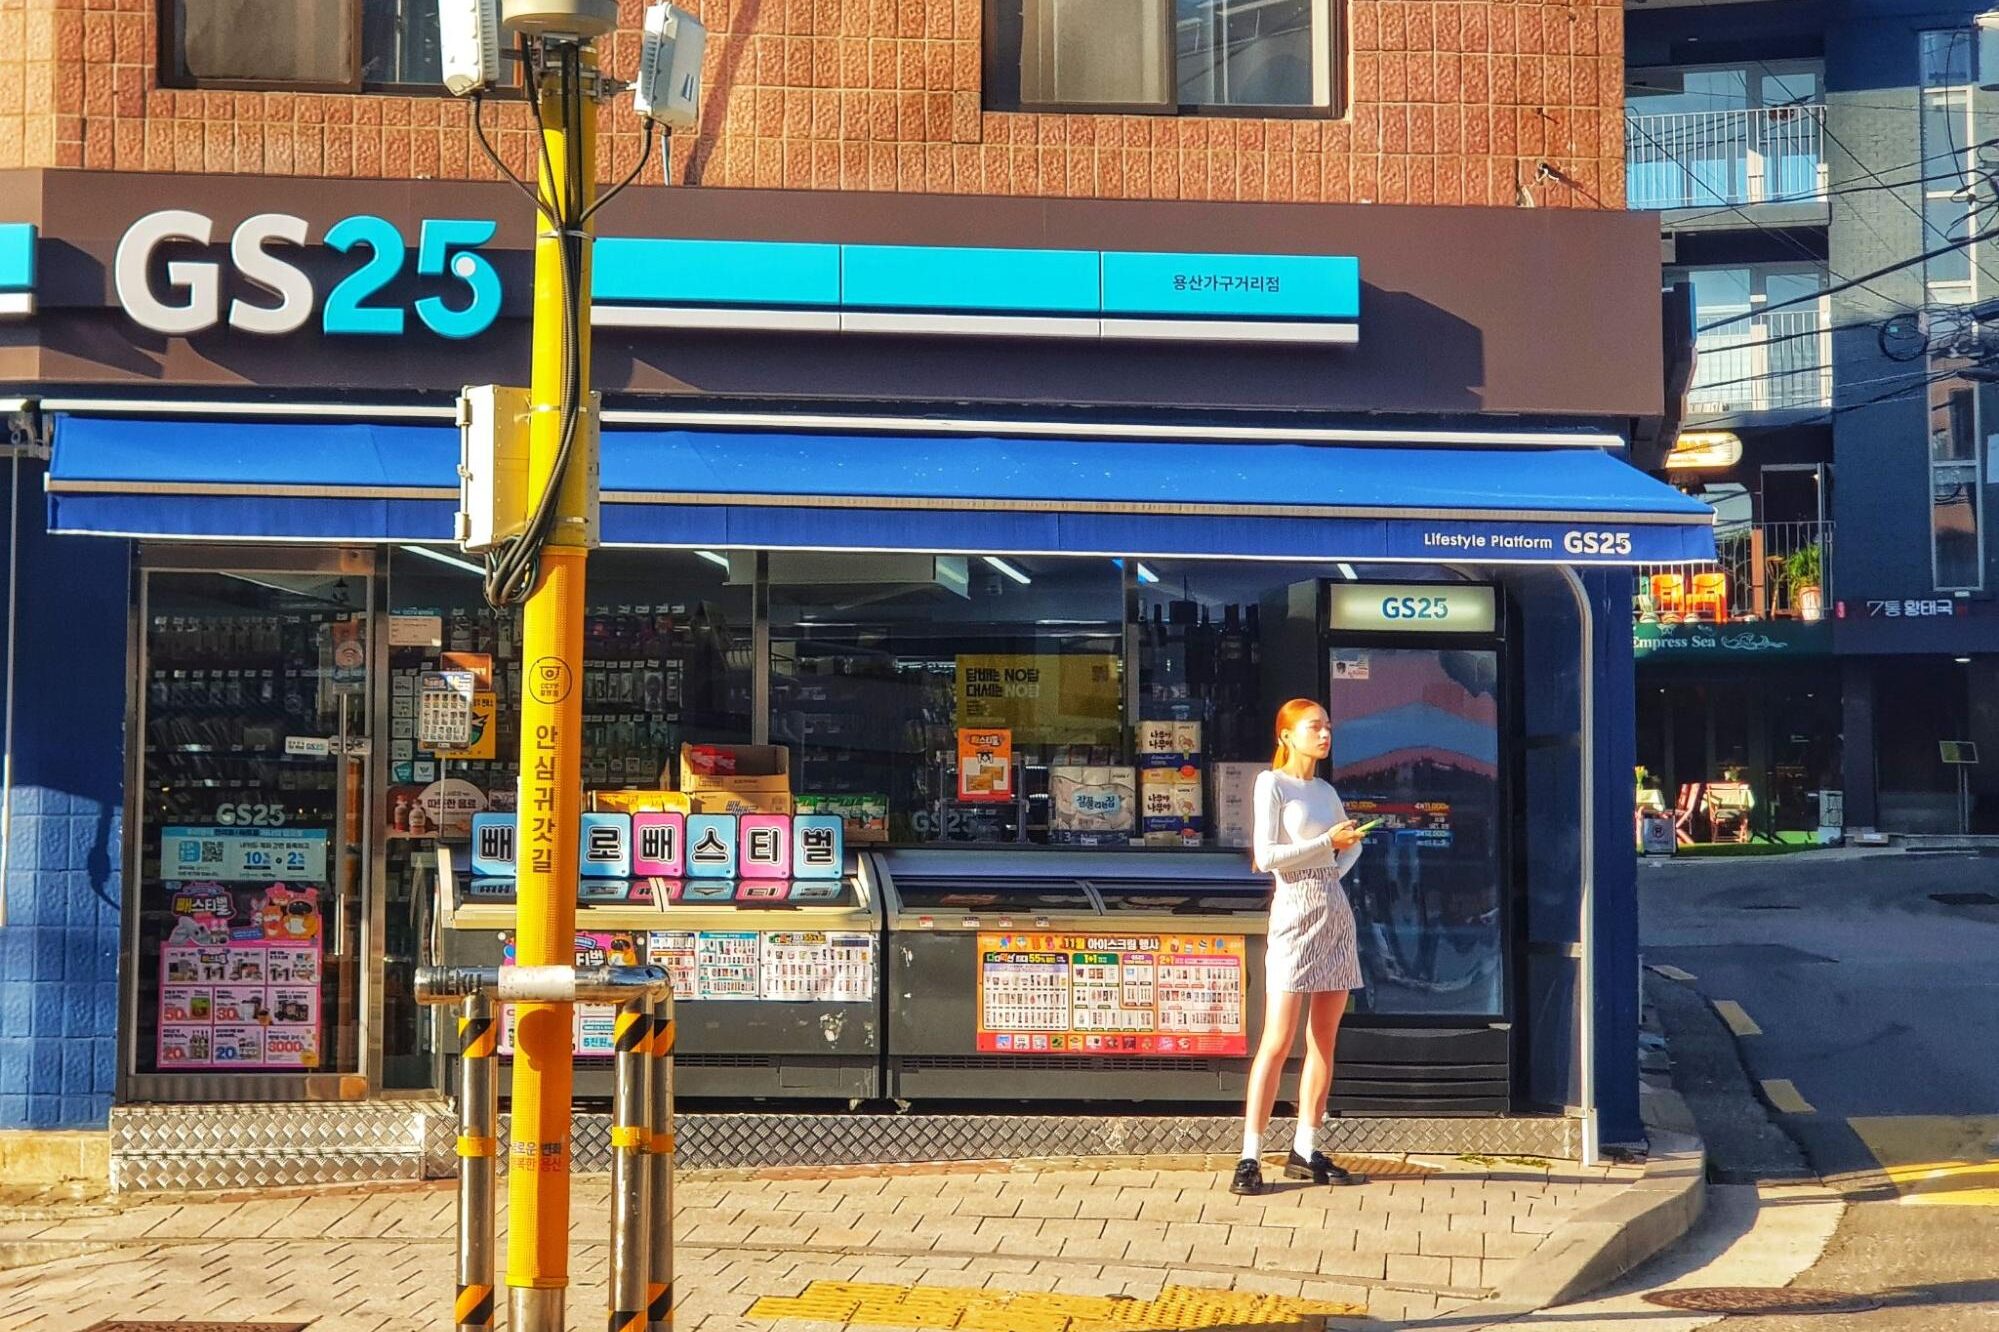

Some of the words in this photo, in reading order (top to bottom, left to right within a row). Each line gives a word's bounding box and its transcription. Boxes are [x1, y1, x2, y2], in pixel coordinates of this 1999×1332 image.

[114, 209, 501, 339] GS25
[1173, 275, 1280, 292] 용산가구거리점
[1424, 532, 1486, 549] Lifestyle
[1491, 534, 1553, 549] Platform
[1563, 531, 1633, 555] GS25
[1382, 597, 1449, 619] GS25
[1867, 600, 1901, 617] 7동
[1904, 599, 1953, 617] 황태국
[1632, 635, 1688, 651] Empress
[1691, 635, 1716, 648] Sea
[966, 667, 1000, 682] 담배는
[531, 725, 559, 874] 안심귀갓길
[215, 802, 286, 826] GS25
[911, 810, 979, 833] GS25
[1087, 938, 1137, 950] 아이스크림
[1138, 938, 1160, 950] 행사
[576, 950, 605, 967] 티벌
